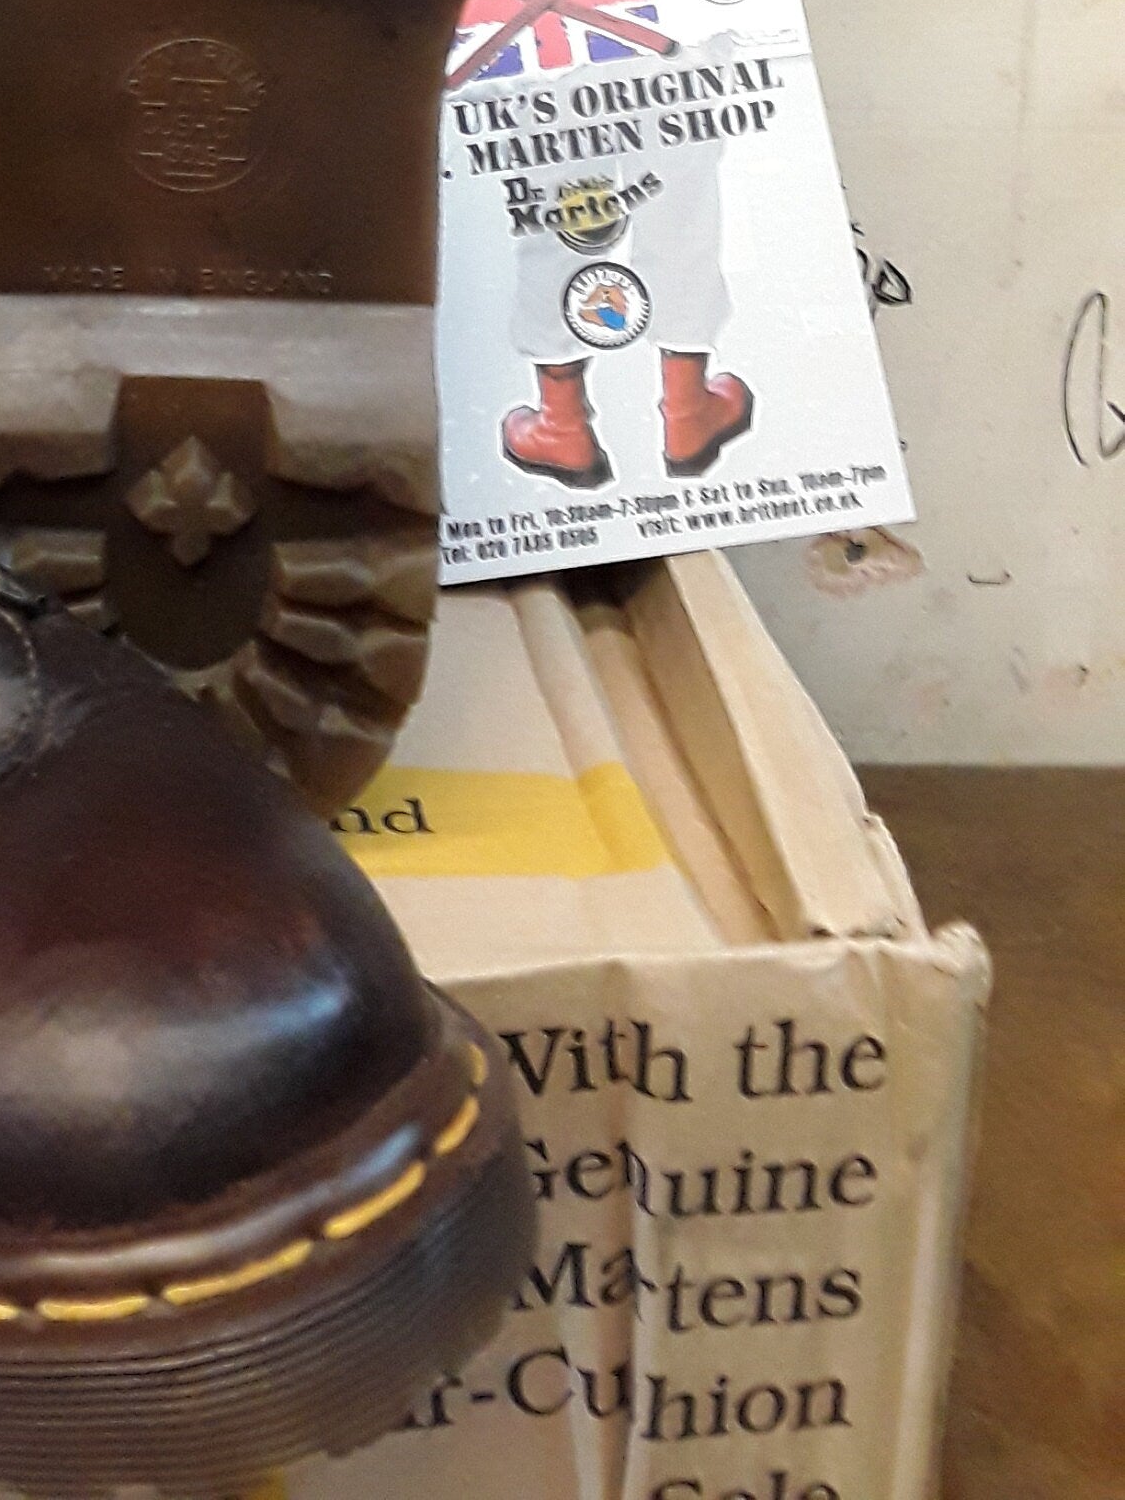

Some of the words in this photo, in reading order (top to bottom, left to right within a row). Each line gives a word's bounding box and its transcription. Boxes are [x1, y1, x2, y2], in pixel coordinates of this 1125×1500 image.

[452, 90, 558, 137] UK'S
[573, 58, 786, 119] ORIGINAL
[467, 120, 644, 175] MARTEN
[658, 99, 775, 148] SHOP
[330, 797, 435, 835] nd
[732, 1019, 887, 1100] the
[512, 1240, 863, 1334] Matens
